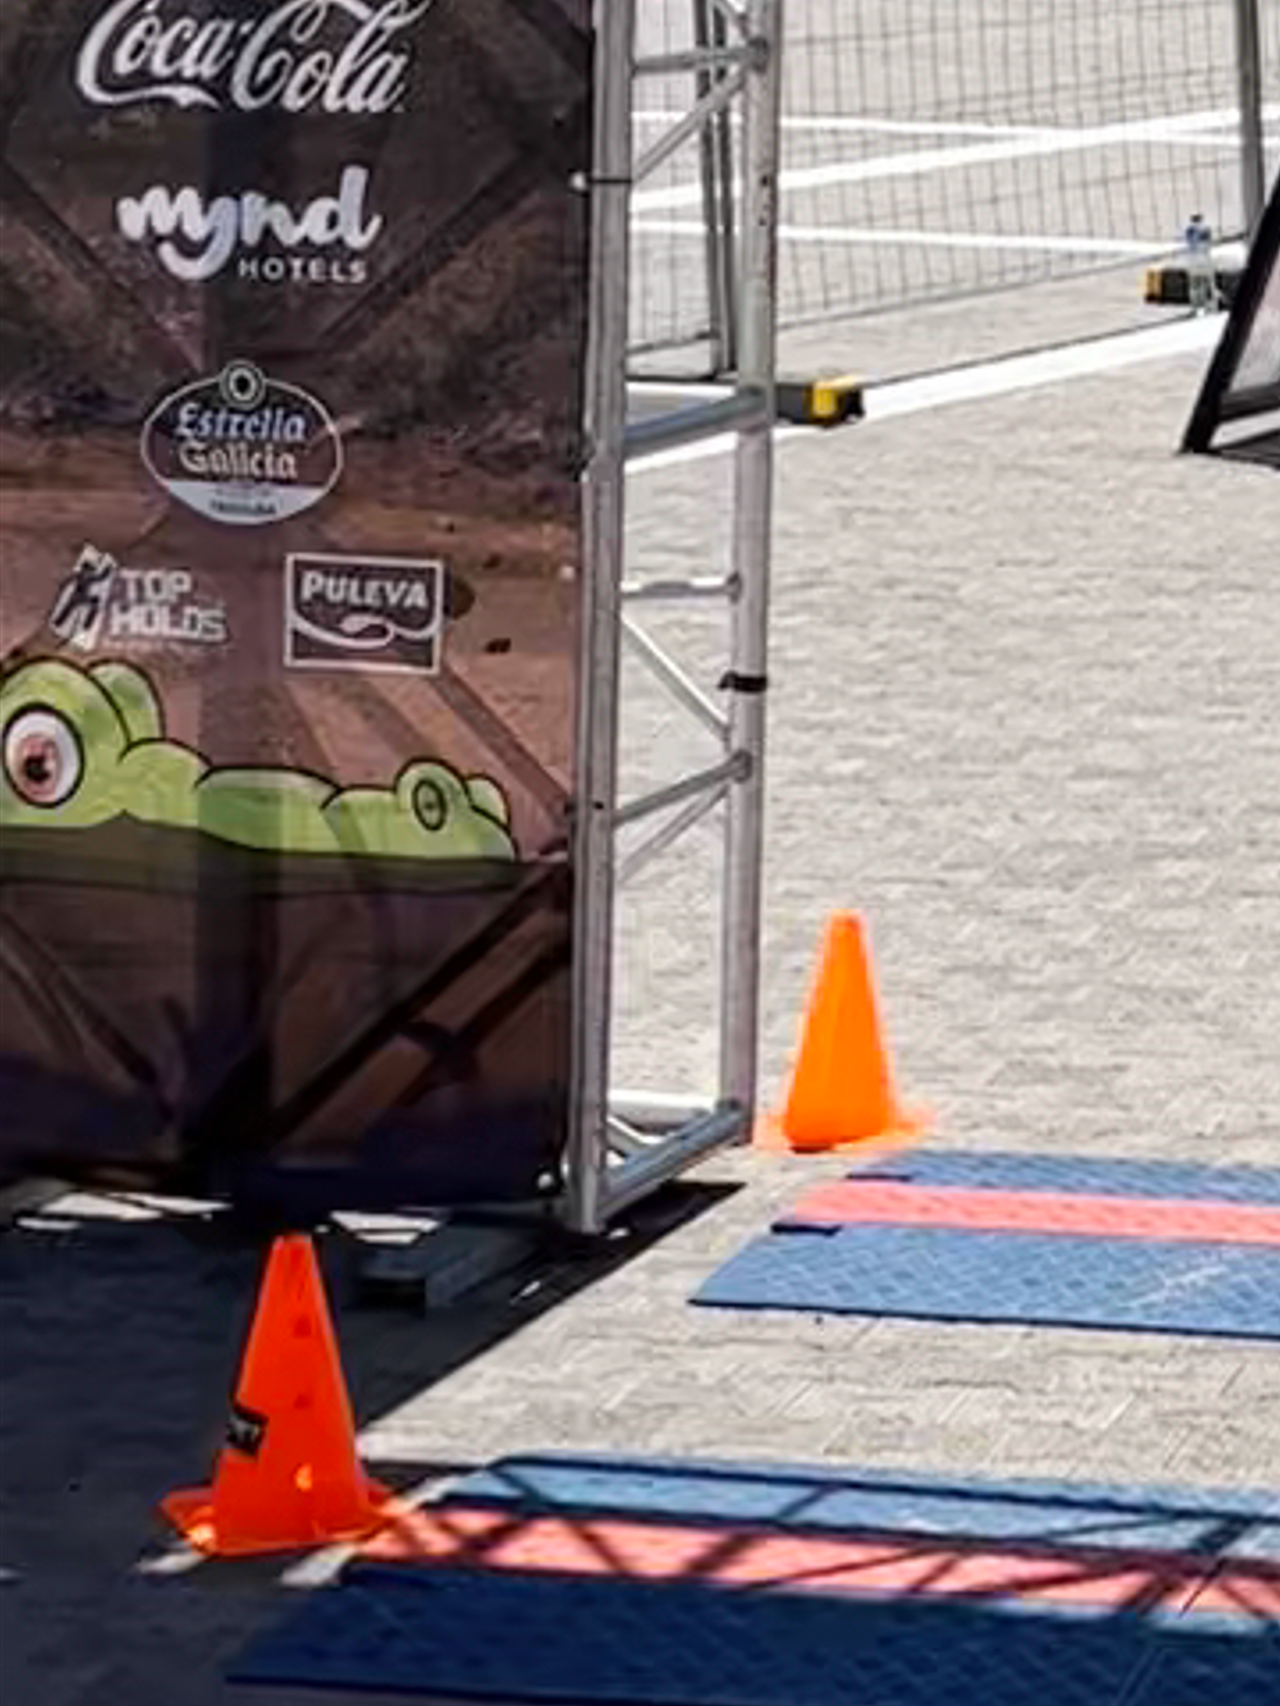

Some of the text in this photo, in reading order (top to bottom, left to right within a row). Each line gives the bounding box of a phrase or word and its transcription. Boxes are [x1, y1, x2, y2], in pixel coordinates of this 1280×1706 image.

[116, 165, 384, 280] mynd
[238, 257, 367, 284] HOTELS
[174, 402, 308, 443] Estrella
[178, 439, 299, 481] Galicia
[118, 568, 192, 603] TOP
[301, 570, 430, 609] PULEVA
[109, 603, 228, 643] HOLDS
